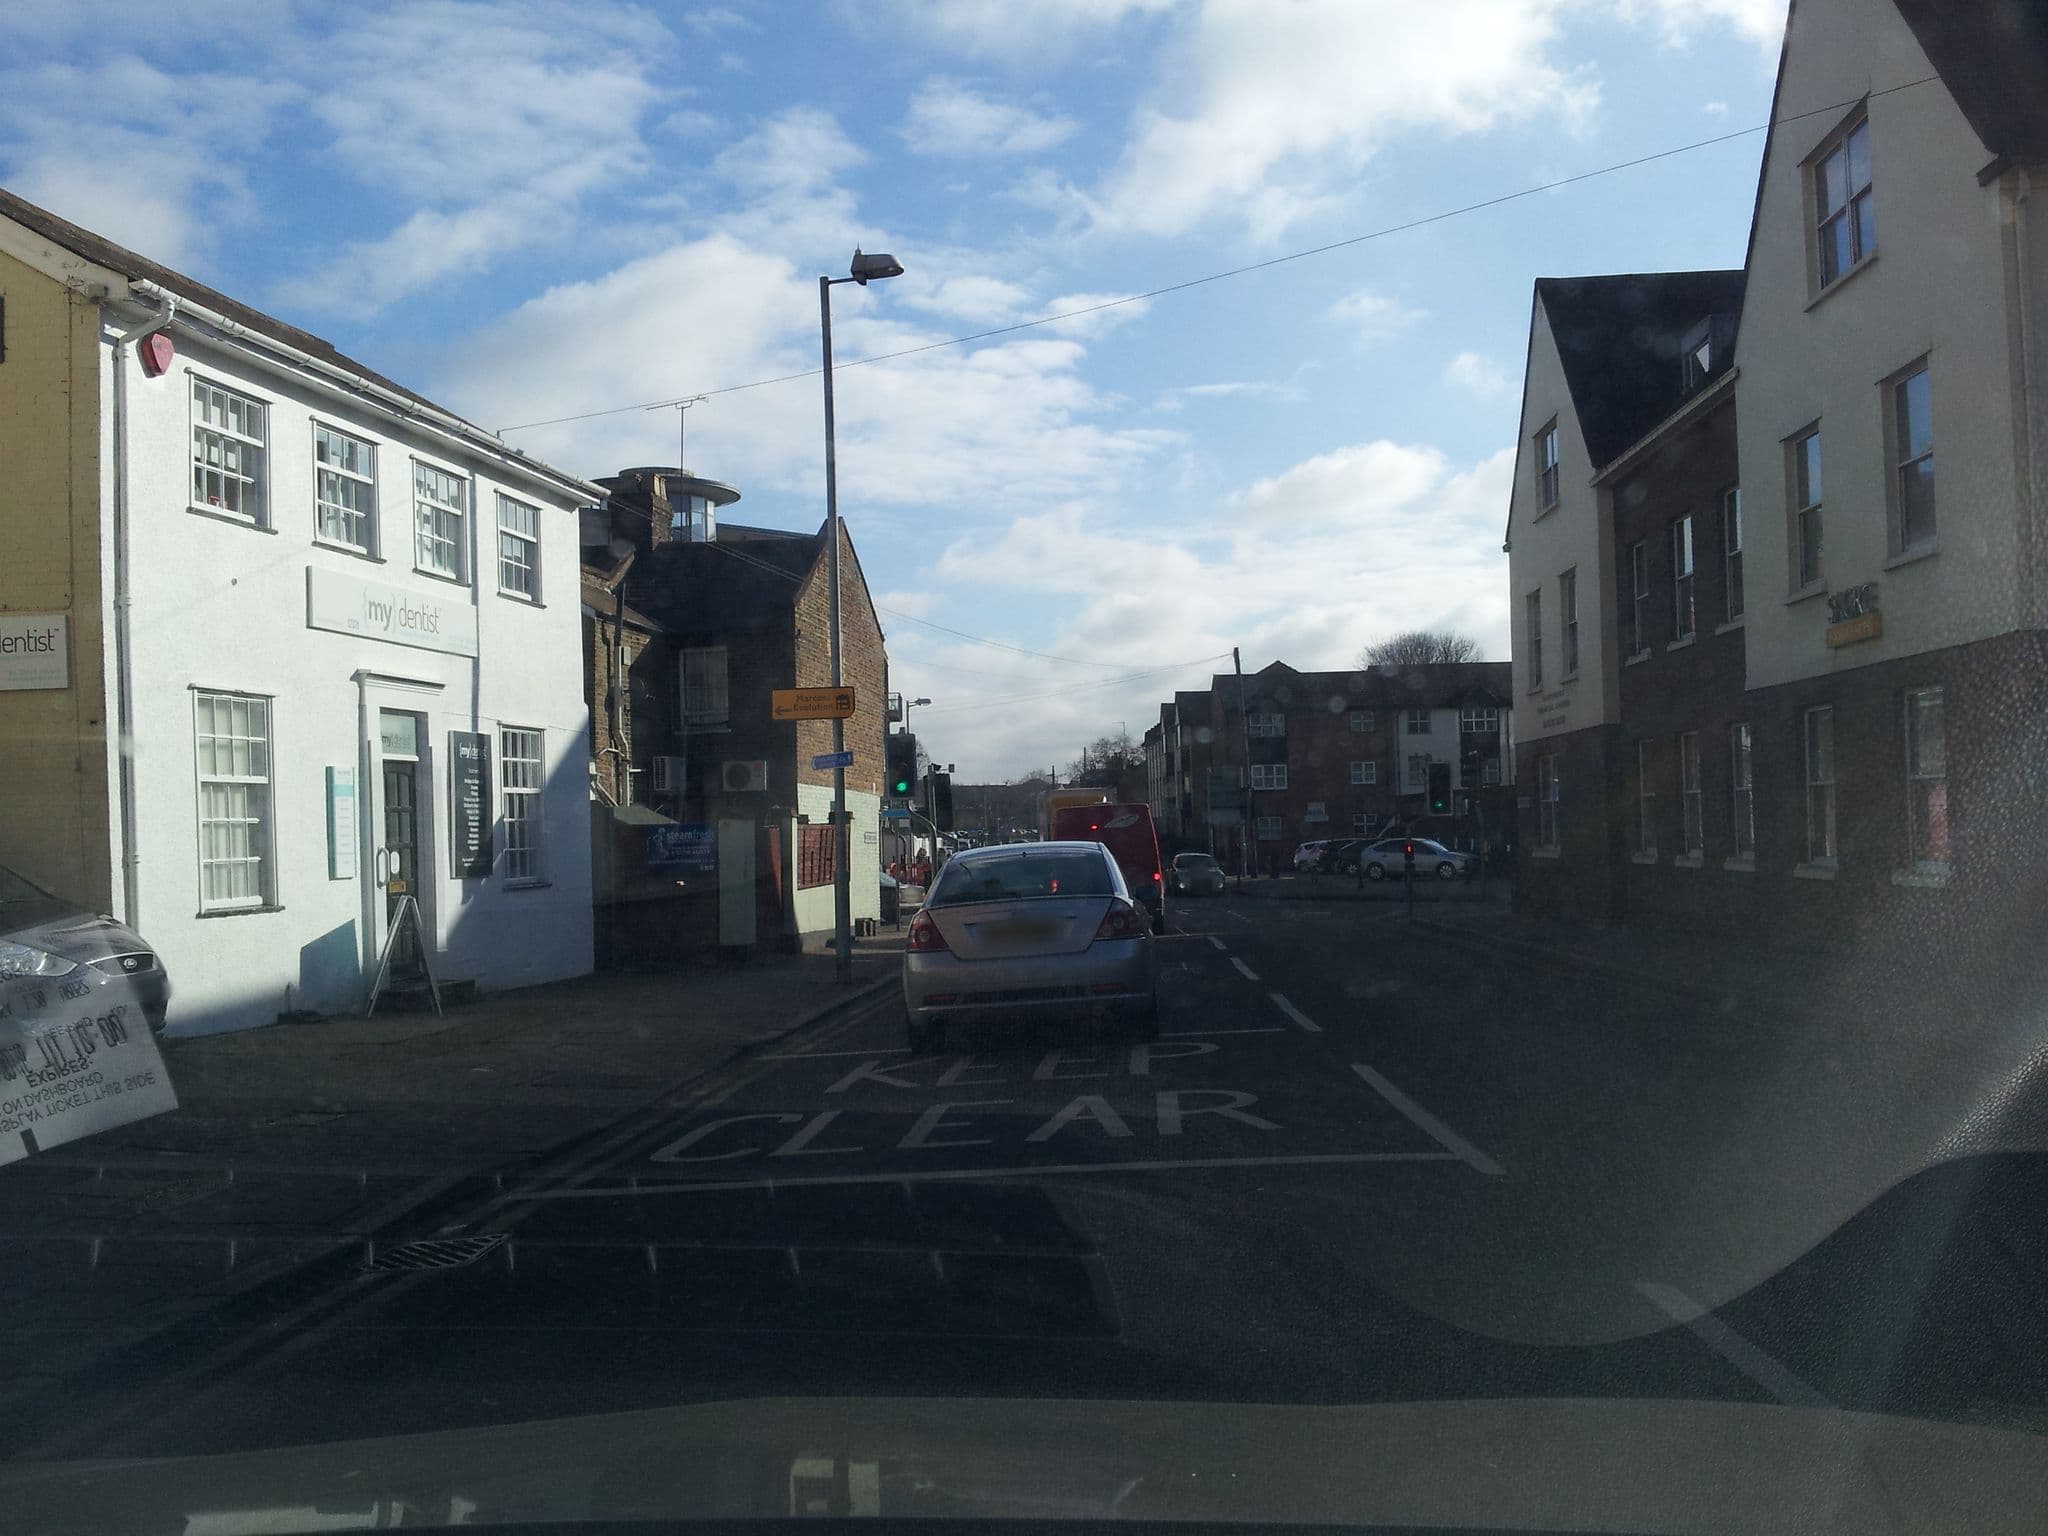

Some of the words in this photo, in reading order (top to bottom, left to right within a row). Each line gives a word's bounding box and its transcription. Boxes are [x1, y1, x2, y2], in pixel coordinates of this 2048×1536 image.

[399, 597, 440, 634] dentist
[0, 628, 54, 653] entist
[824, 1042, 1219, 1093] KEEP
[649, 1089, 1284, 1162] CLEAR
